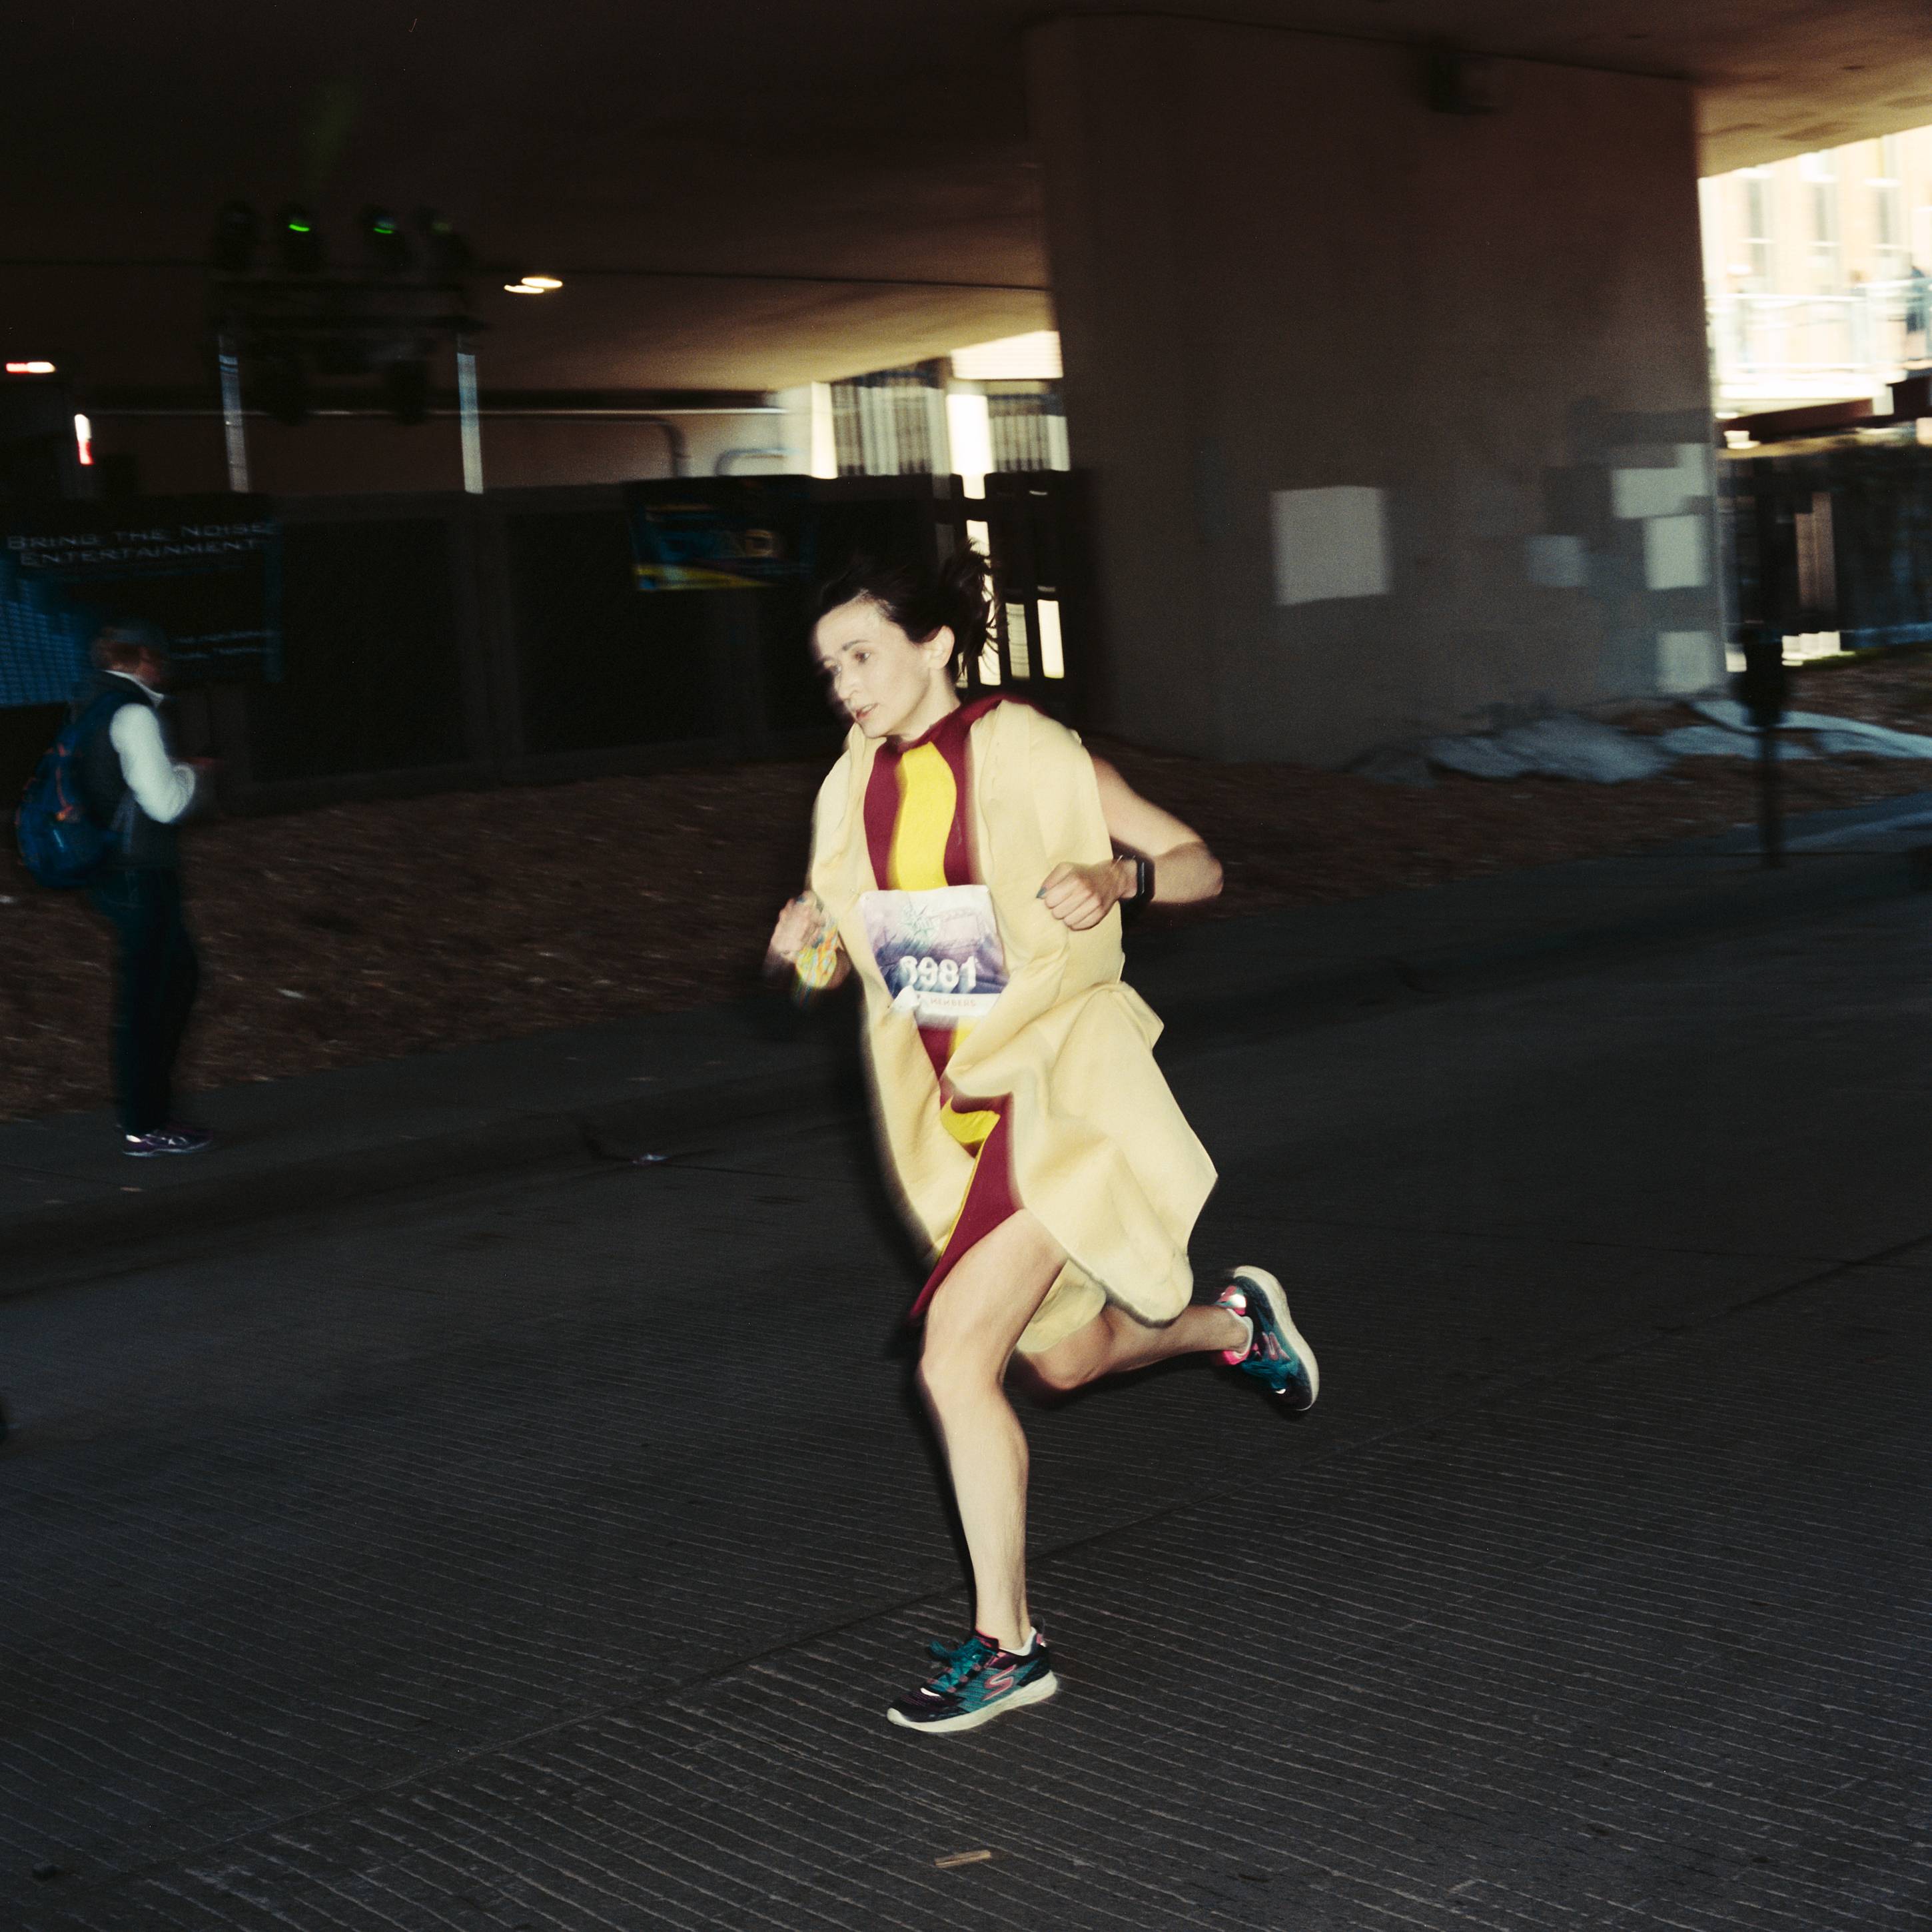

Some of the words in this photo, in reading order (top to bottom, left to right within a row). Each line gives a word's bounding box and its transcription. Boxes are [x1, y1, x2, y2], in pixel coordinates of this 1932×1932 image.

[7, 534, 98, 551] BRING
[115, 528, 171, 542] THE
[181, 522, 276, 537] NOISE
[21, 539, 260, 567] ENTERTAINMENT
